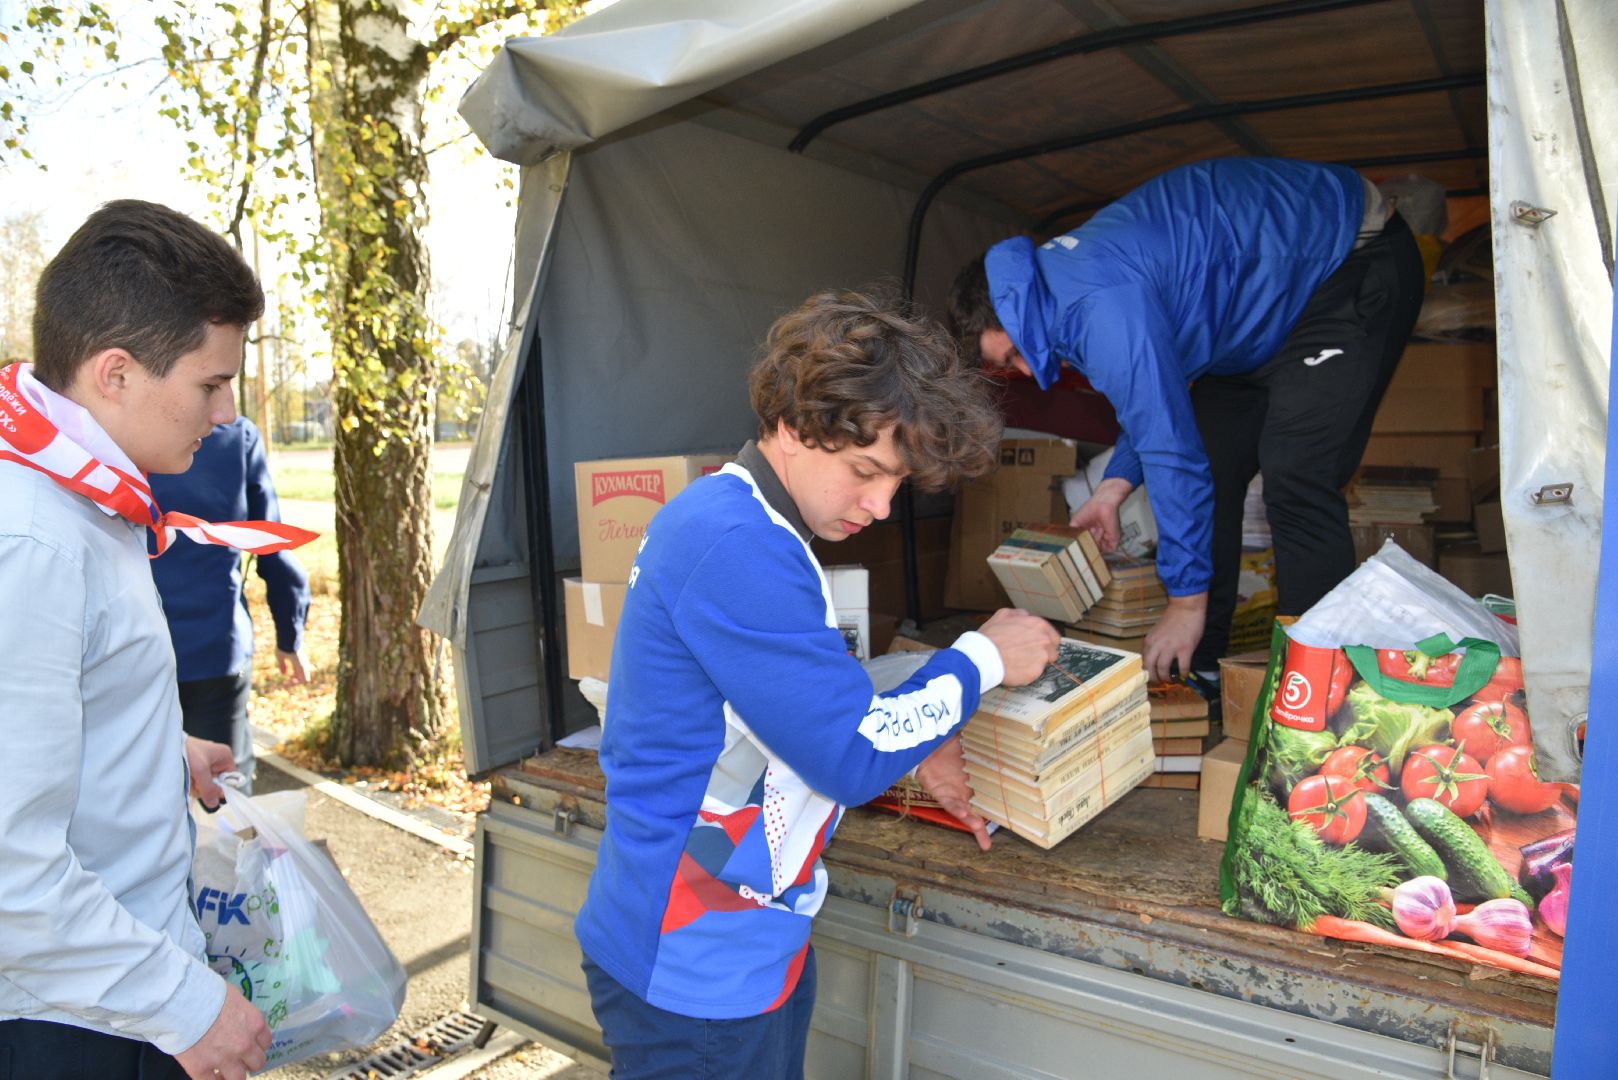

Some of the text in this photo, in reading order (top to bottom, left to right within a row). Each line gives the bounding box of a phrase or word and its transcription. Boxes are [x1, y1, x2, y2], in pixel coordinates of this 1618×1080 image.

[0, 382, 27, 416] одёжи
[594, 474, 661, 497] КУХМАСТЕР
[598, 518, 648, 542] Печен
